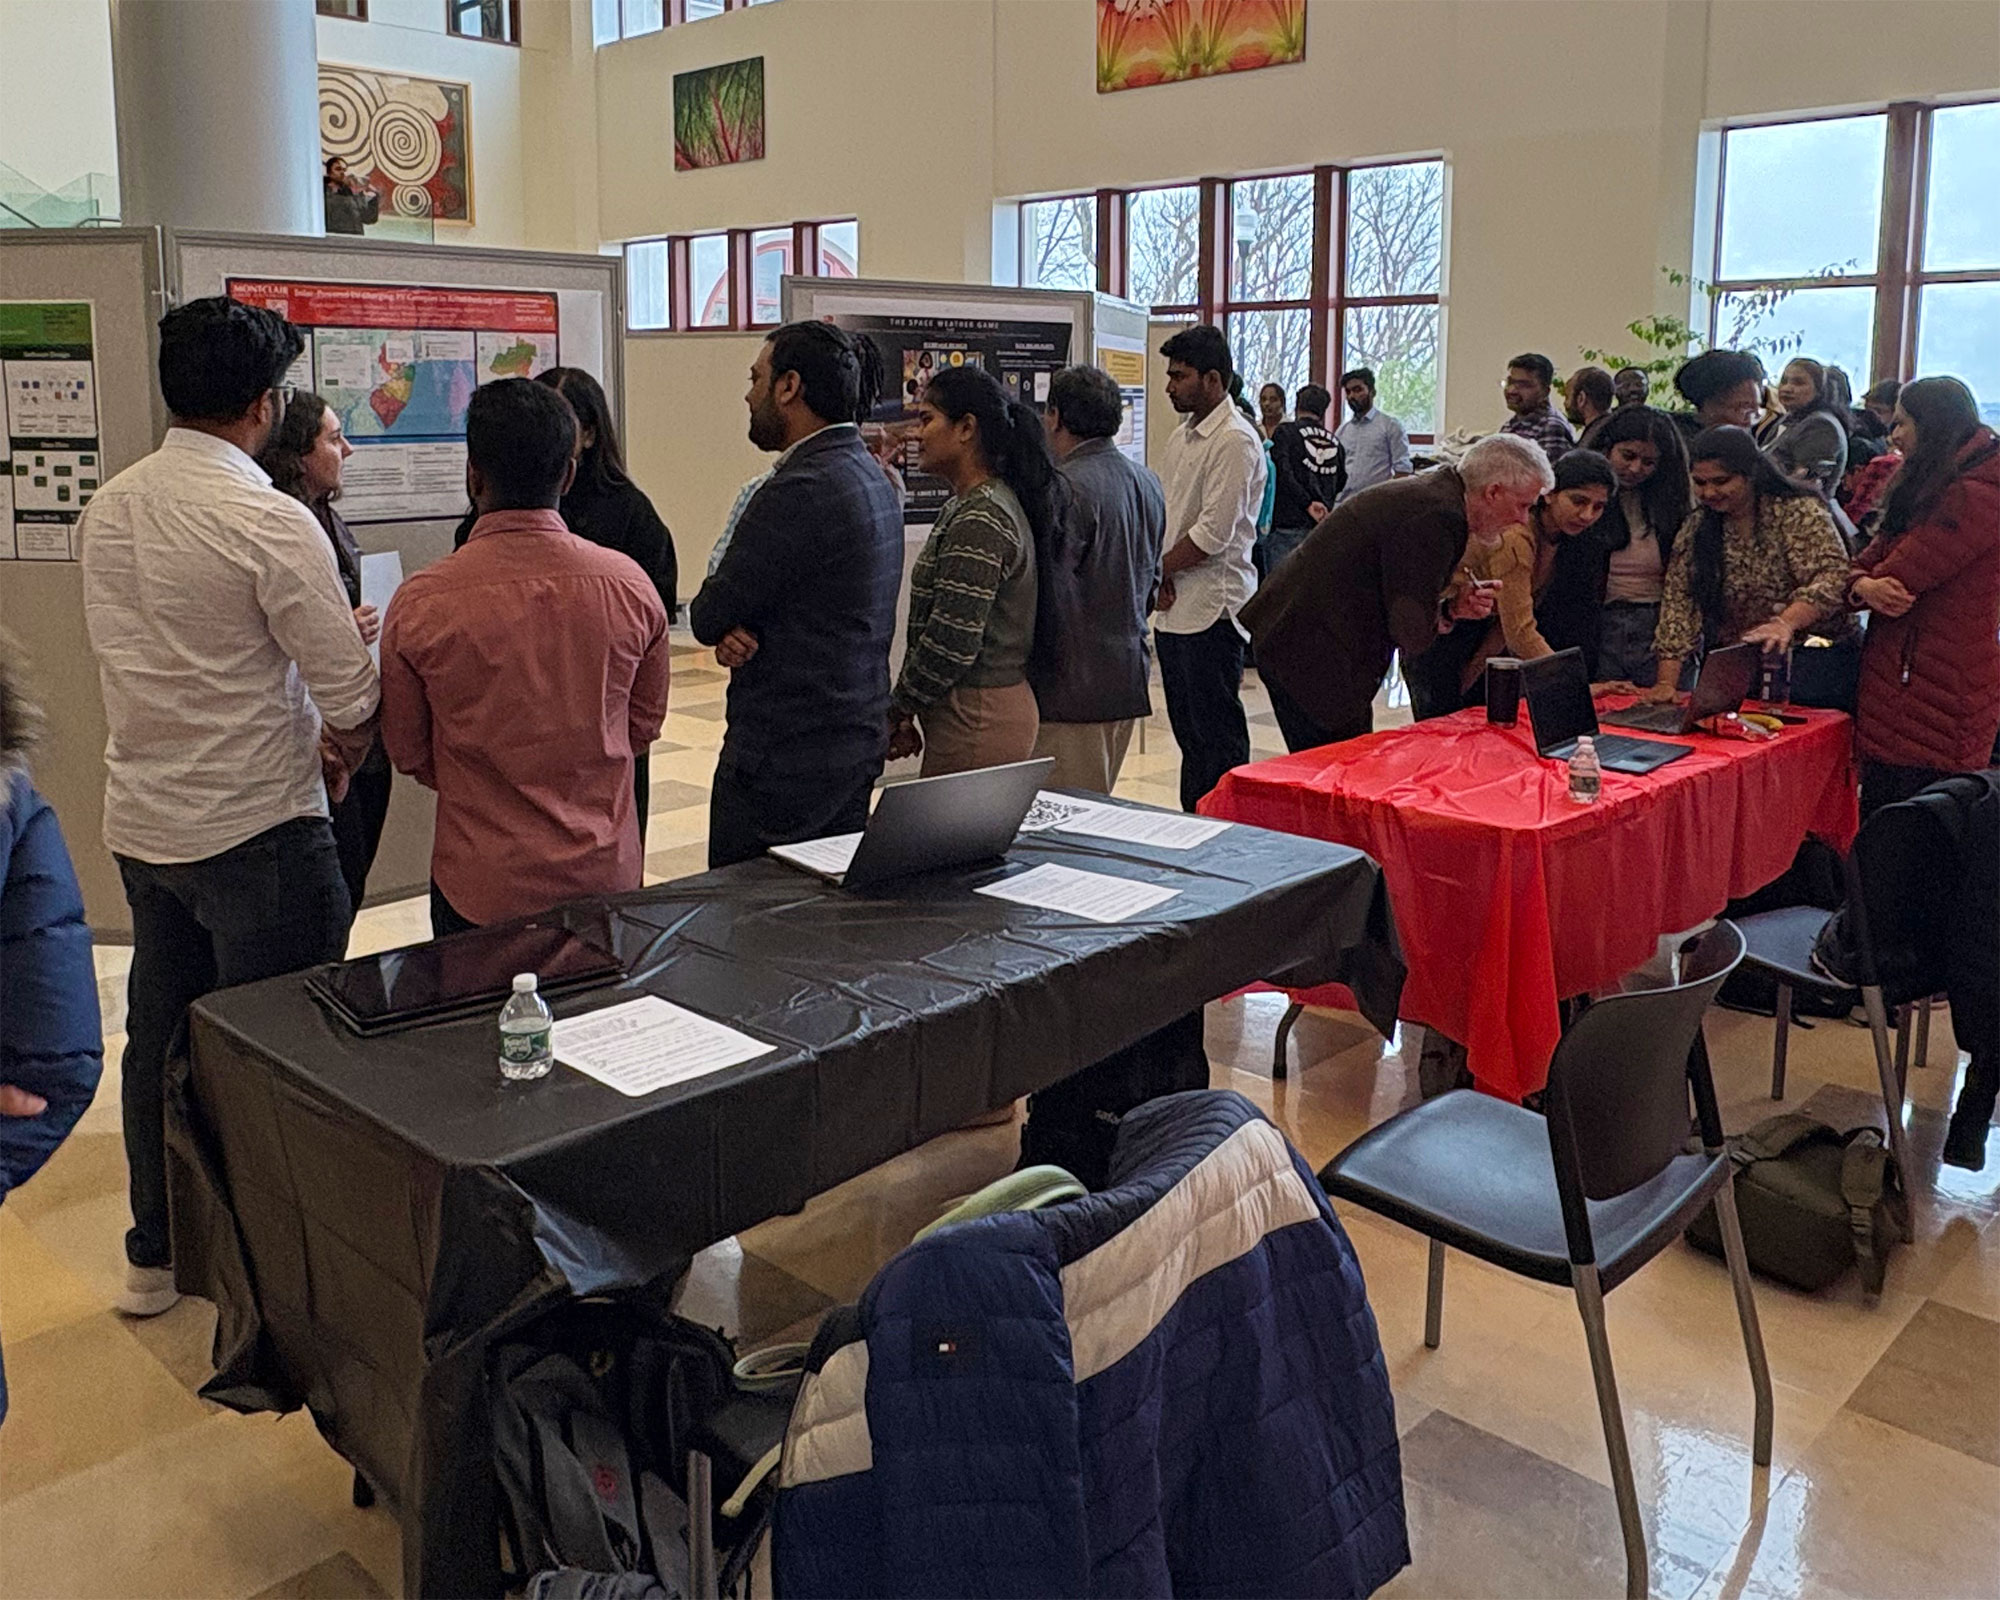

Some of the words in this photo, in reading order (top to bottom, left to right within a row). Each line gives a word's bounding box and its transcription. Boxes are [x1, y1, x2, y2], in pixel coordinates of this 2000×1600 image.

[234, 284, 288, 294] MONTCLAIR
[890, 317, 905, 326] THE
[908, 318, 934, 327] SPACE
[937, 319, 974, 328] WEATHER
[977, 320, 999, 329] GAME
